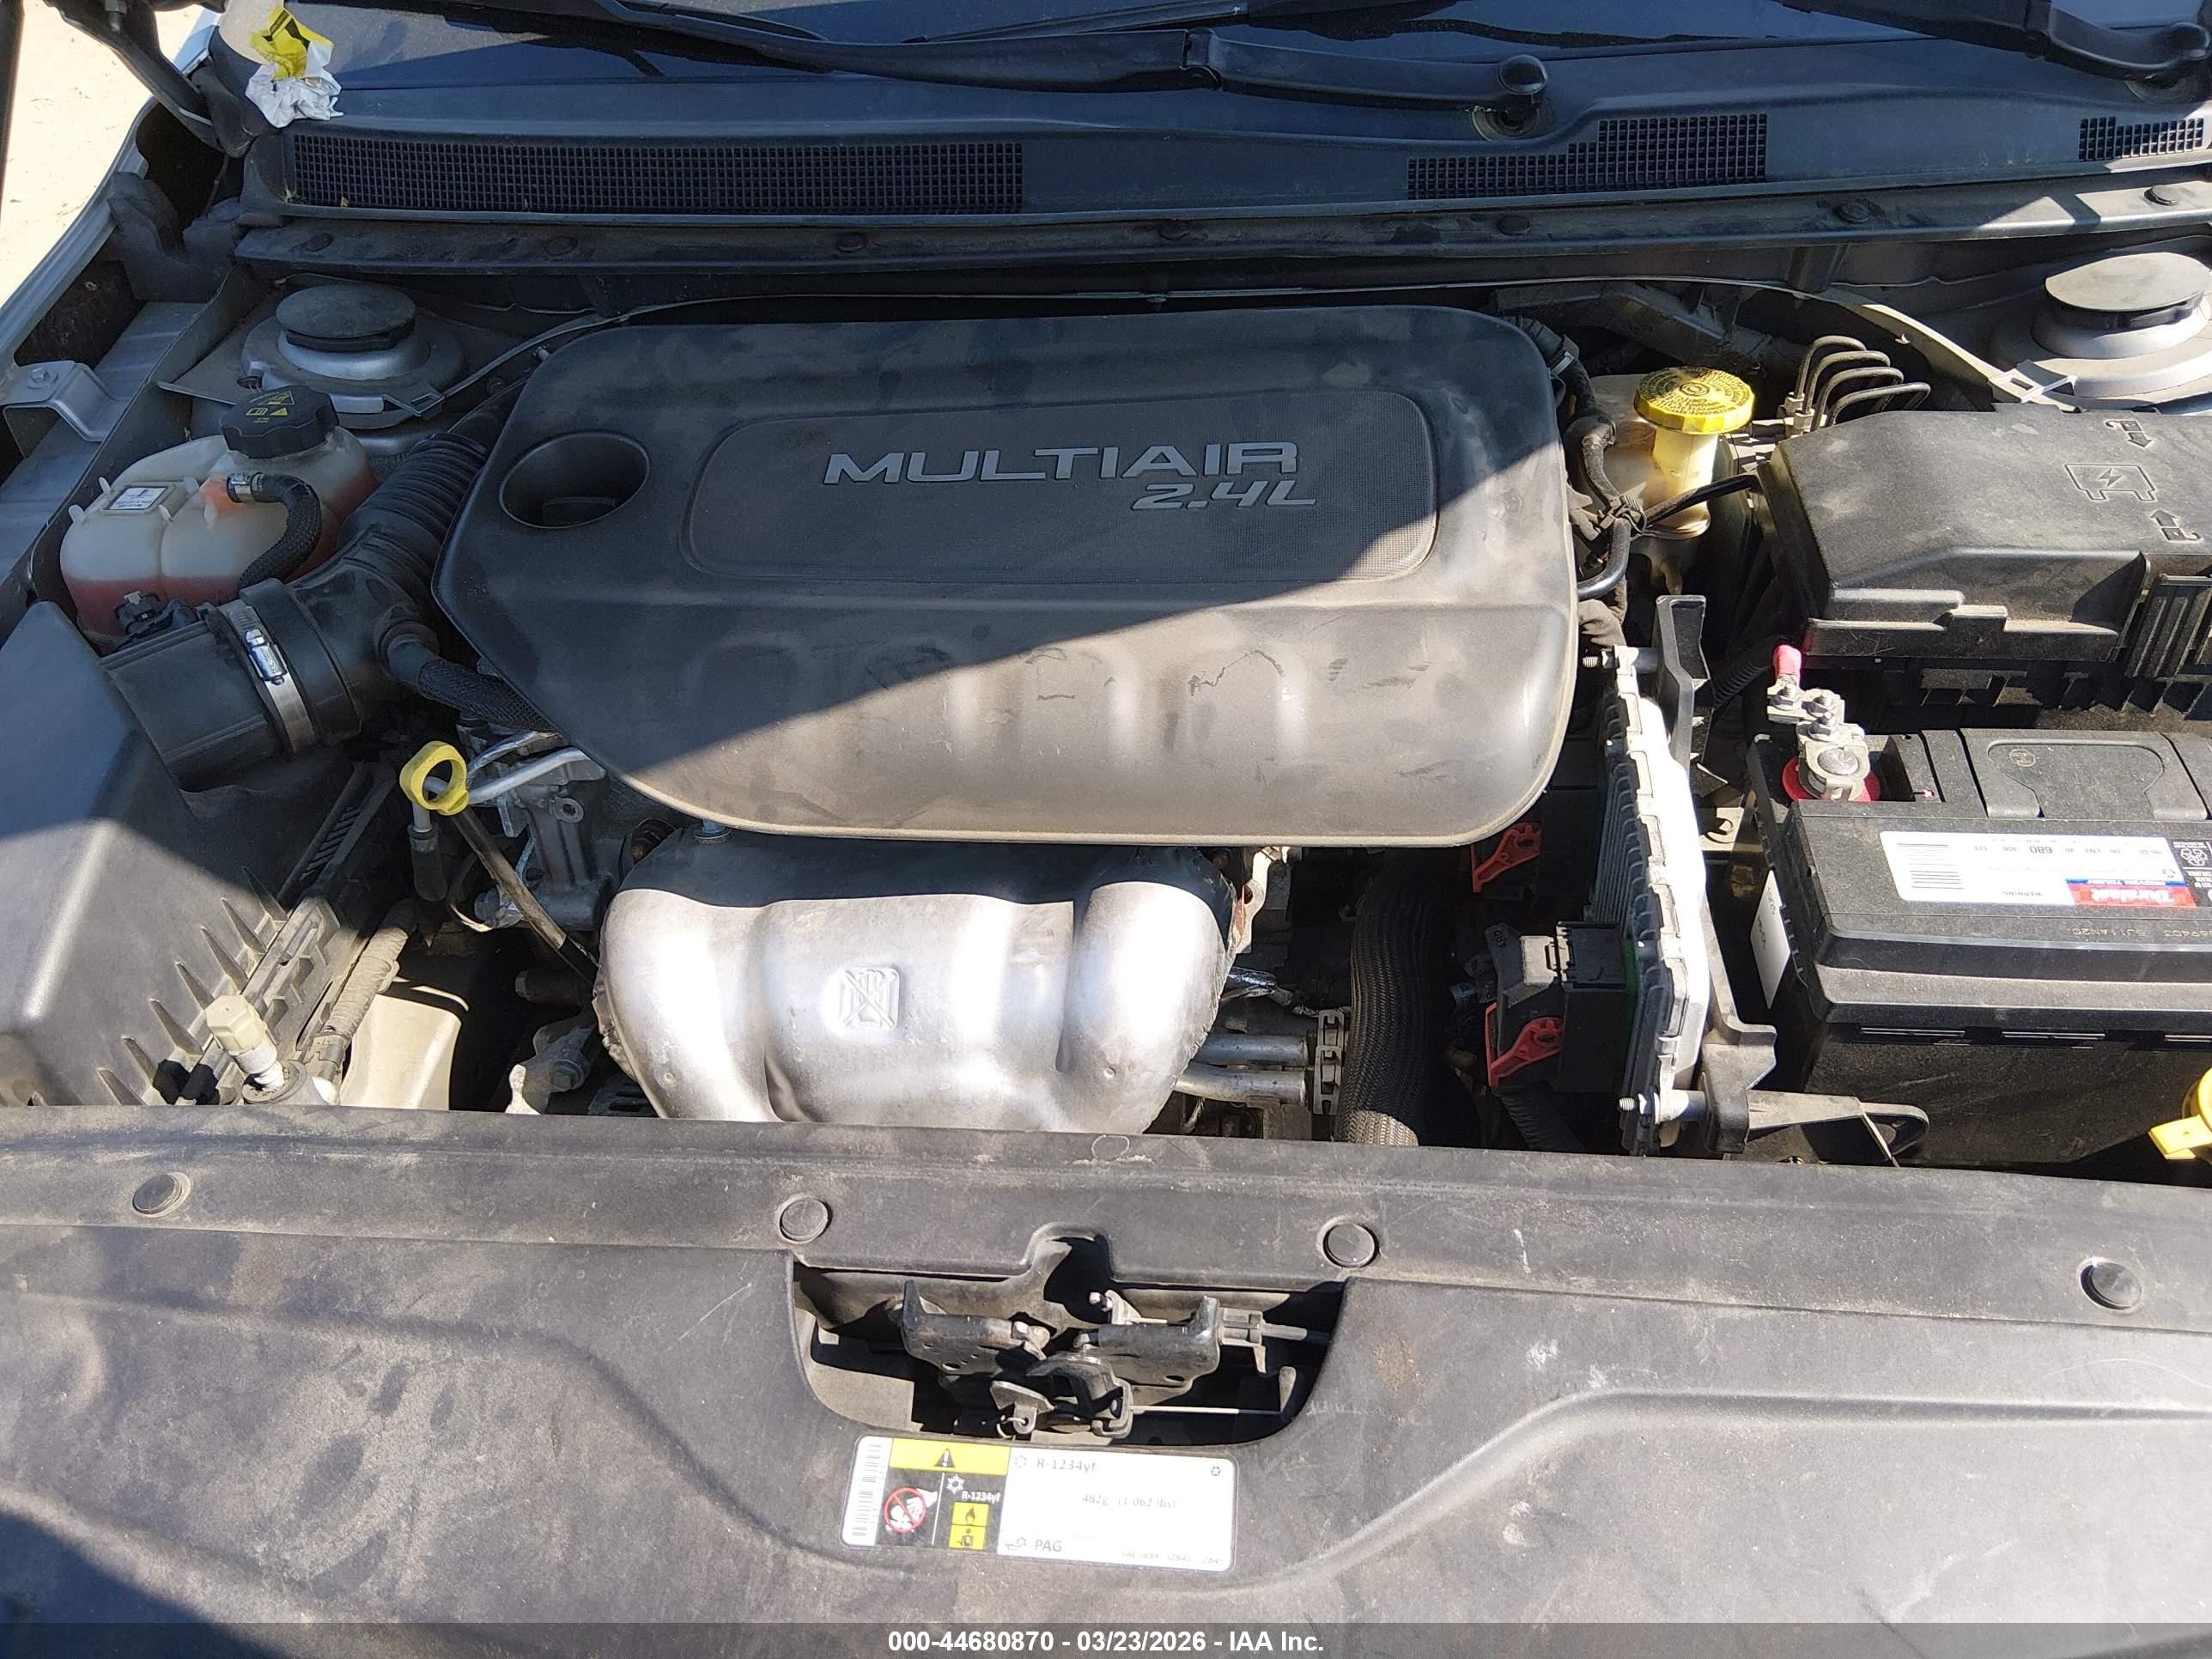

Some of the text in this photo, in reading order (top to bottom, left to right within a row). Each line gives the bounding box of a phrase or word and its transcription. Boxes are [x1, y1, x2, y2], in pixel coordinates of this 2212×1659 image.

[823, 441, 1298, 484] MULTIAIR
[1132, 480, 1317, 510] 2.4L
[2029, 845, 2053, 854] 680
[2091, 888, 2173, 903] Duralast
[1036, 1457, 1097, 1474] R-1234yf
[961, 1490, 1002, 1504] R-1234yf
[1034, 1538, 1062, 1553] PAG
